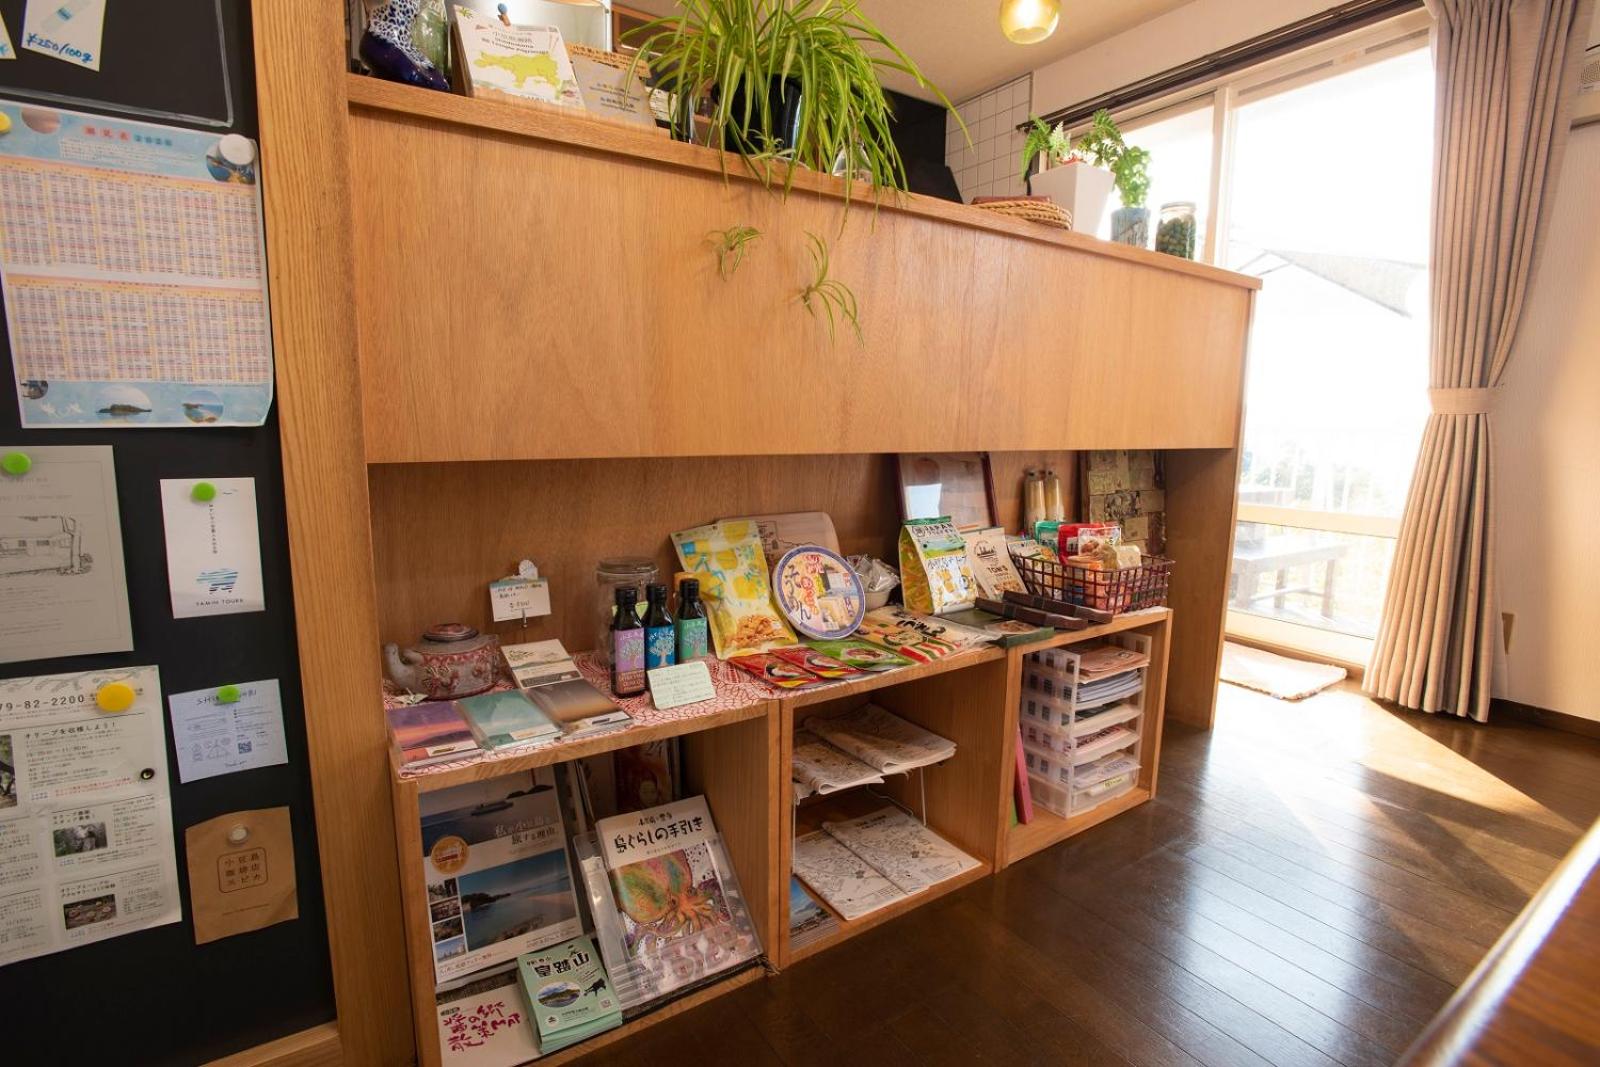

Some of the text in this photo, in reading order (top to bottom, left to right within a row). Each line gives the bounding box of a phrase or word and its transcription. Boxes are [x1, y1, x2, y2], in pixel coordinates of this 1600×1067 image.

[613, 816, 704, 854] 島ぐらしの手引き
